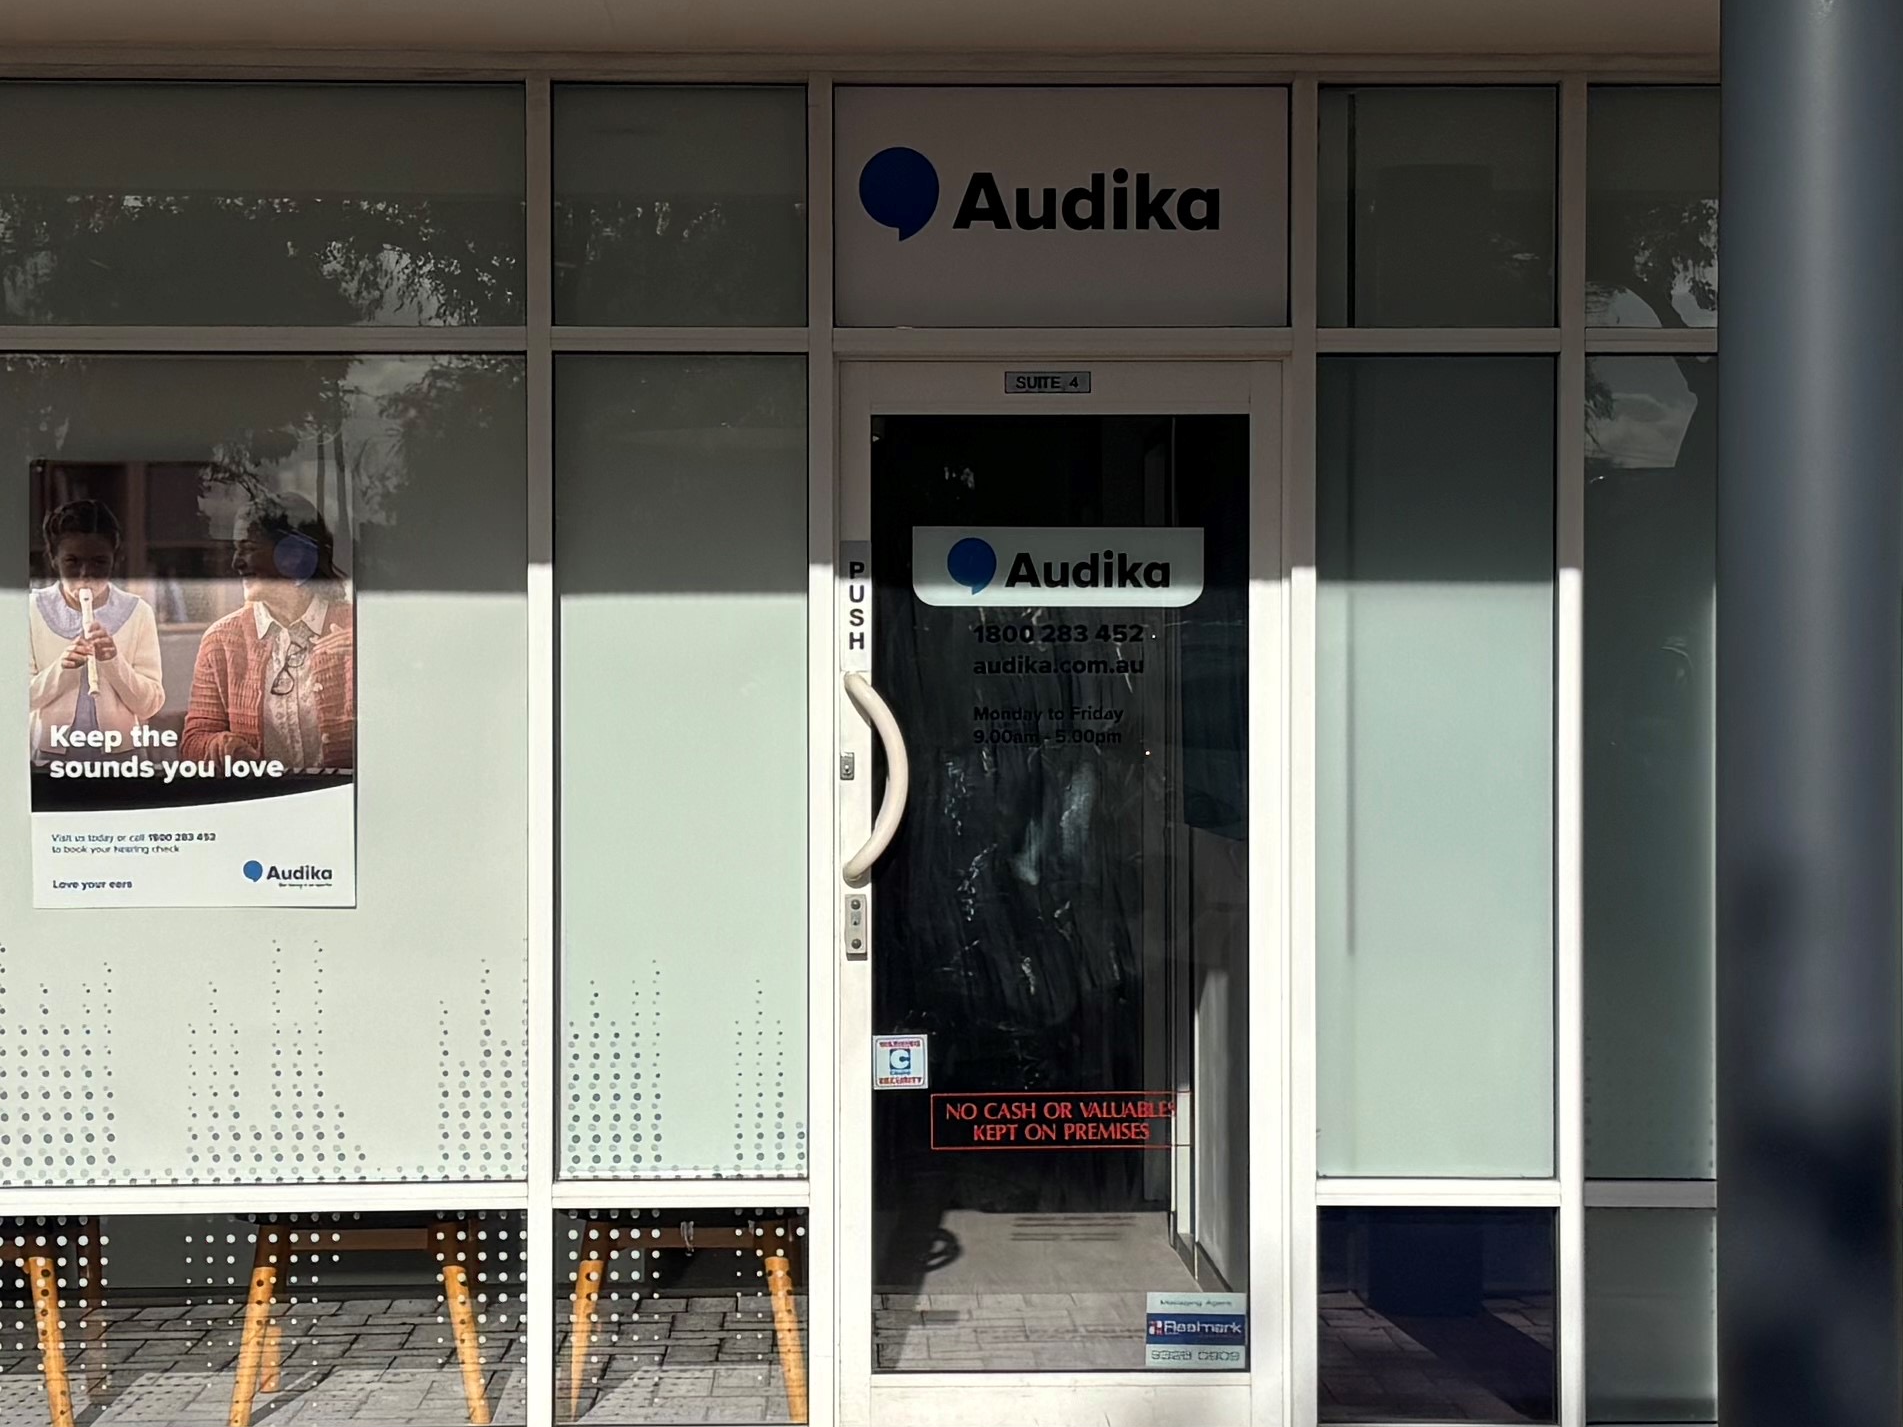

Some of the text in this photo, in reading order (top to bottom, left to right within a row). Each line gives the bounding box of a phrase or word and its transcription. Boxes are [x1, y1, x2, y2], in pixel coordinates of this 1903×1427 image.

[951, 167, 1221, 231] Audika
[1015, 375, 1079, 390] SUITE 4
[1005, 550, 1172, 590] Audika
[848, 561, 866, 651] PUSH
[973, 624, 1144, 643] 1800 283 452
[973, 655, 1145, 675] audika.com.au
[973, 705, 1124, 725] Monday to Friday
[49, 724, 178, 751] Keep the
[973, 729, 1040, 744] 9.00am
[1055, 729, 1122, 746] 5.00pm
[49, 755, 285, 784] sounds you love
[88, 834, 114, 844] today
[129, 834, 145, 843] call
[174, 833, 195, 842] 283
[63, 845, 88, 854] book
[90, 846, 112, 855] your
[151, 845, 180, 854] check
[266, 864, 333, 881] Audika
[52, 880, 133, 891] Love your ears
[945, 1102, 978, 1121] NO
[984, 1101, 1036, 1120] CASH
[1042, 1100, 1073, 1120] OR
[973, 1121, 1151, 1142] KEPT ON PREMISES
